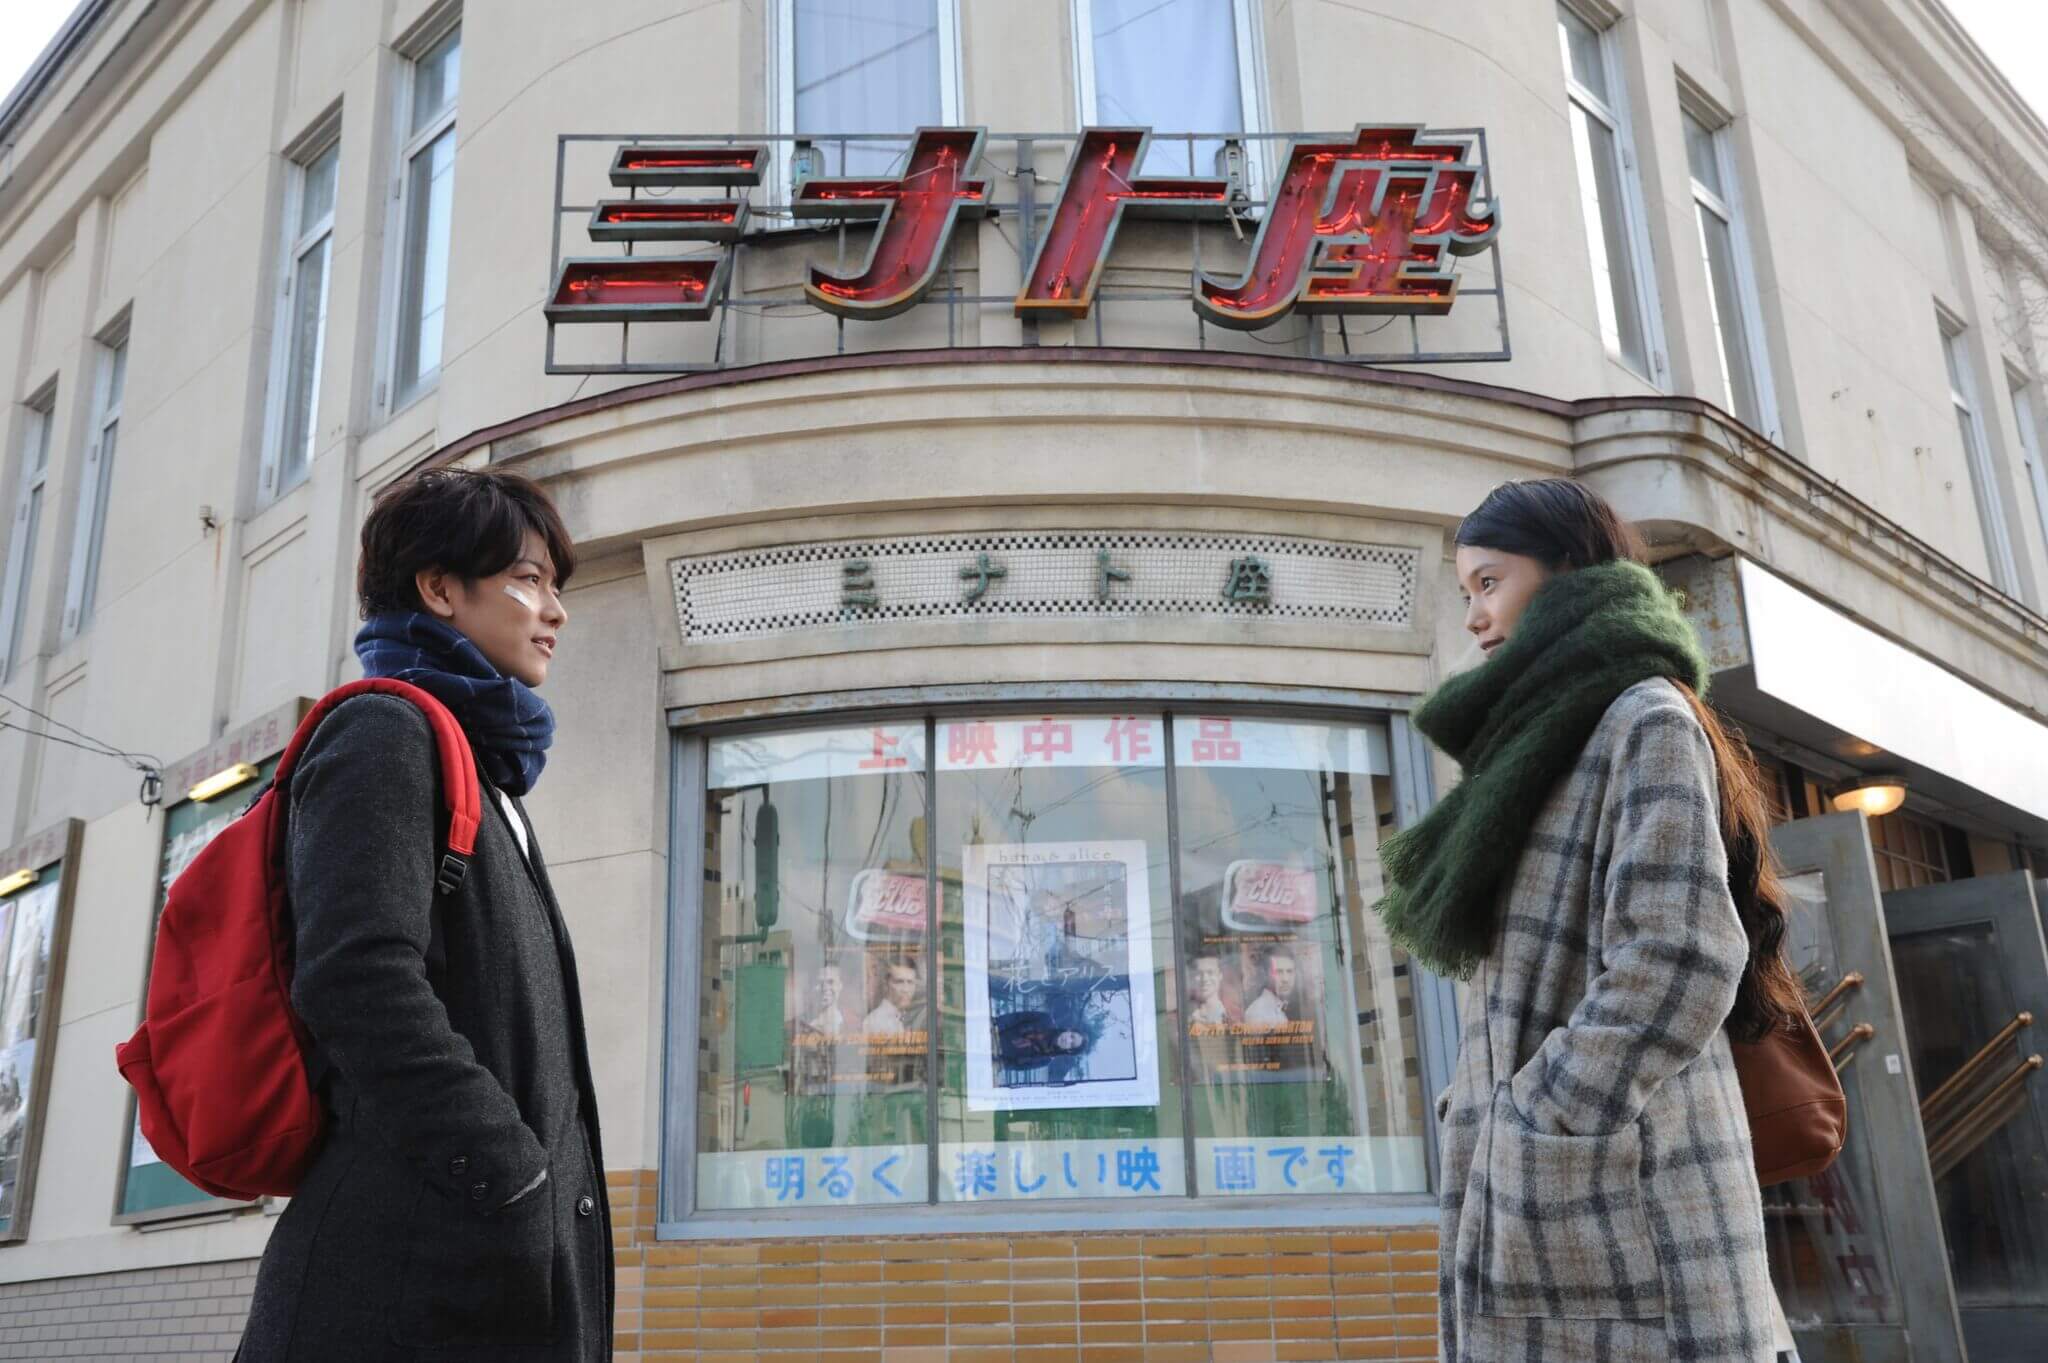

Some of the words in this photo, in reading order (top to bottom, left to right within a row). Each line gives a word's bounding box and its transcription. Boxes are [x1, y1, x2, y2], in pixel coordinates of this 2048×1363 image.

[544, 123, 1499, 330] ミナト座
[842, 548, 1272, 607] ミナト座
[859, 715, 1242, 769] 上映中作品
[1002, 962, 1118, 994] 花とアリス
[766, 1144, 1354, 1201] 明るく楽しい映画です
